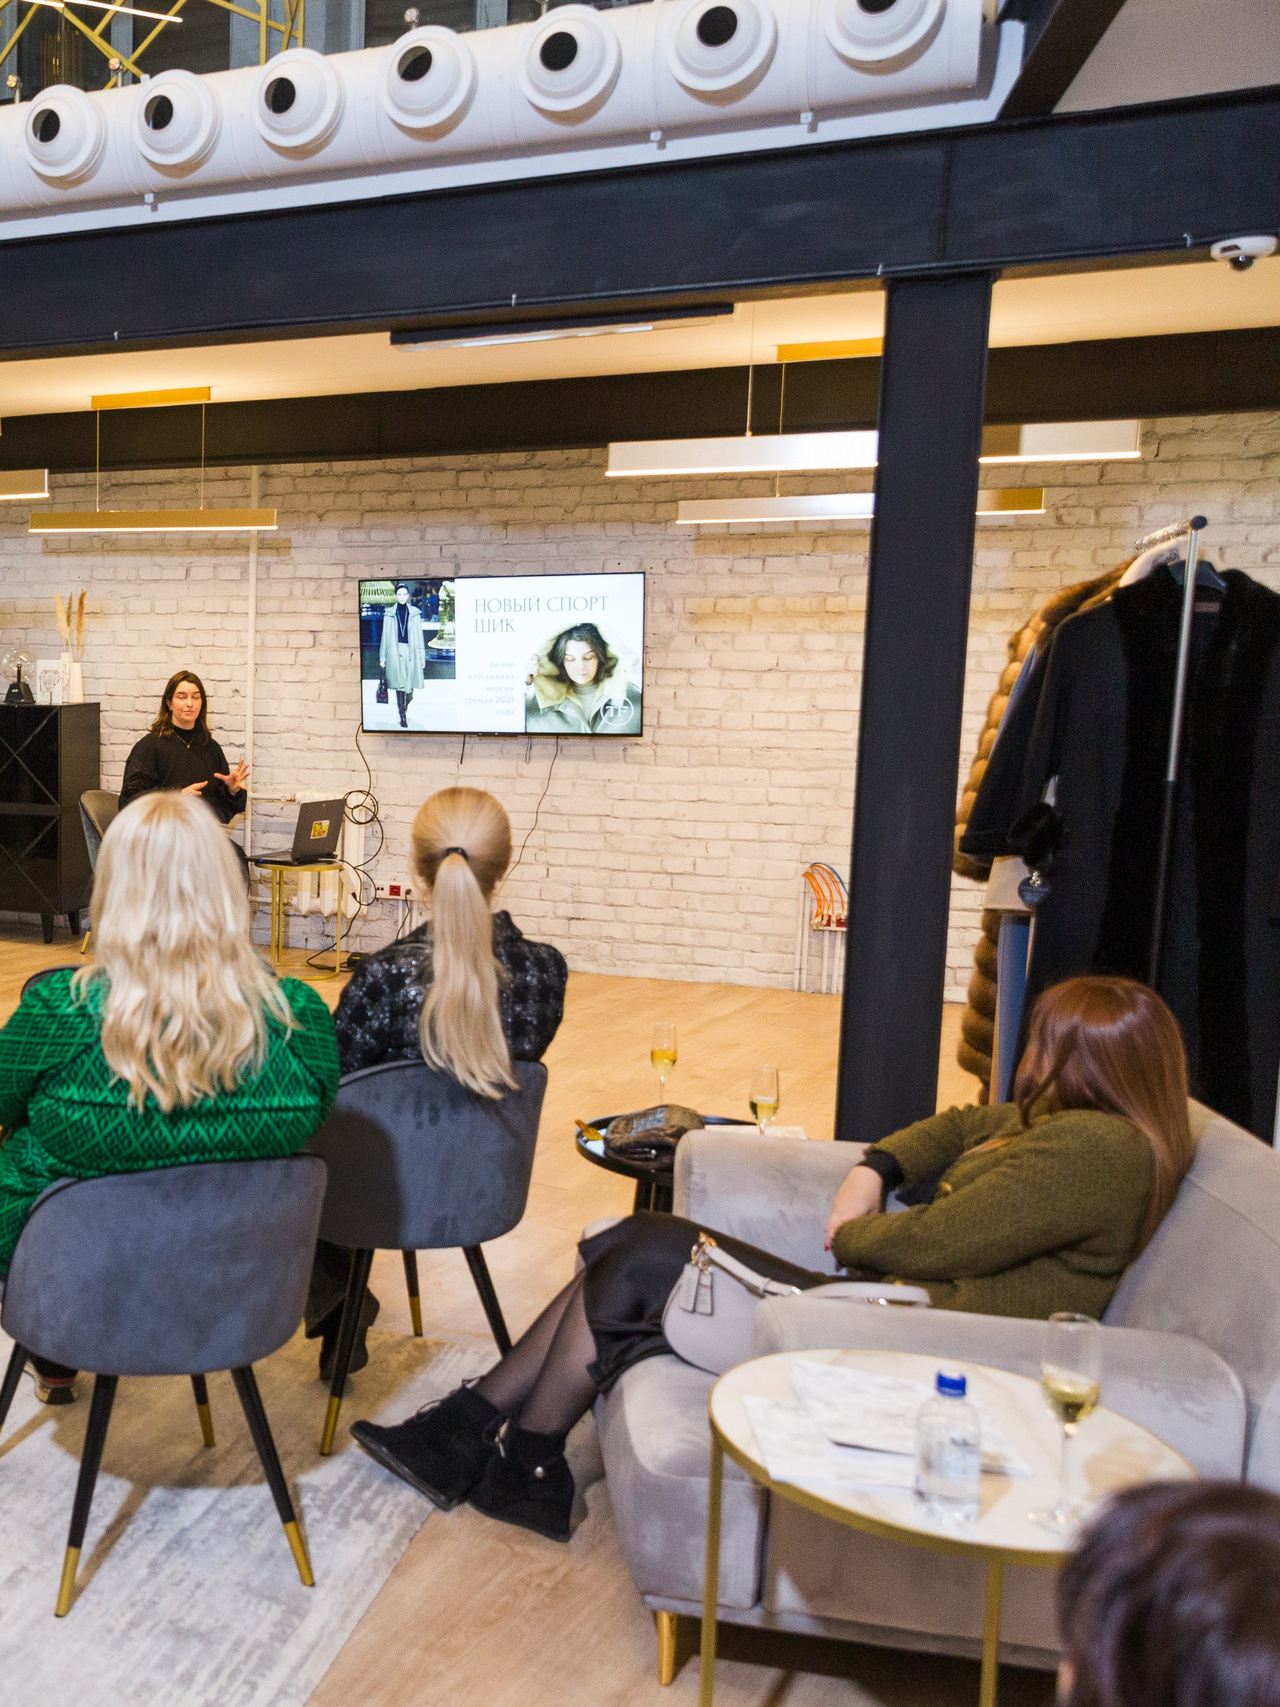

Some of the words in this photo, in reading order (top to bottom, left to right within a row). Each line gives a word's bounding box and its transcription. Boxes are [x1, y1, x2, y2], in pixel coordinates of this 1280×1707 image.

[475, 596, 540, 613] НОВЫЙ
[547, 596, 609, 611] СПОРТ
[475, 618, 515, 633] ШИК
[495, 695, 514, 703] 2021
